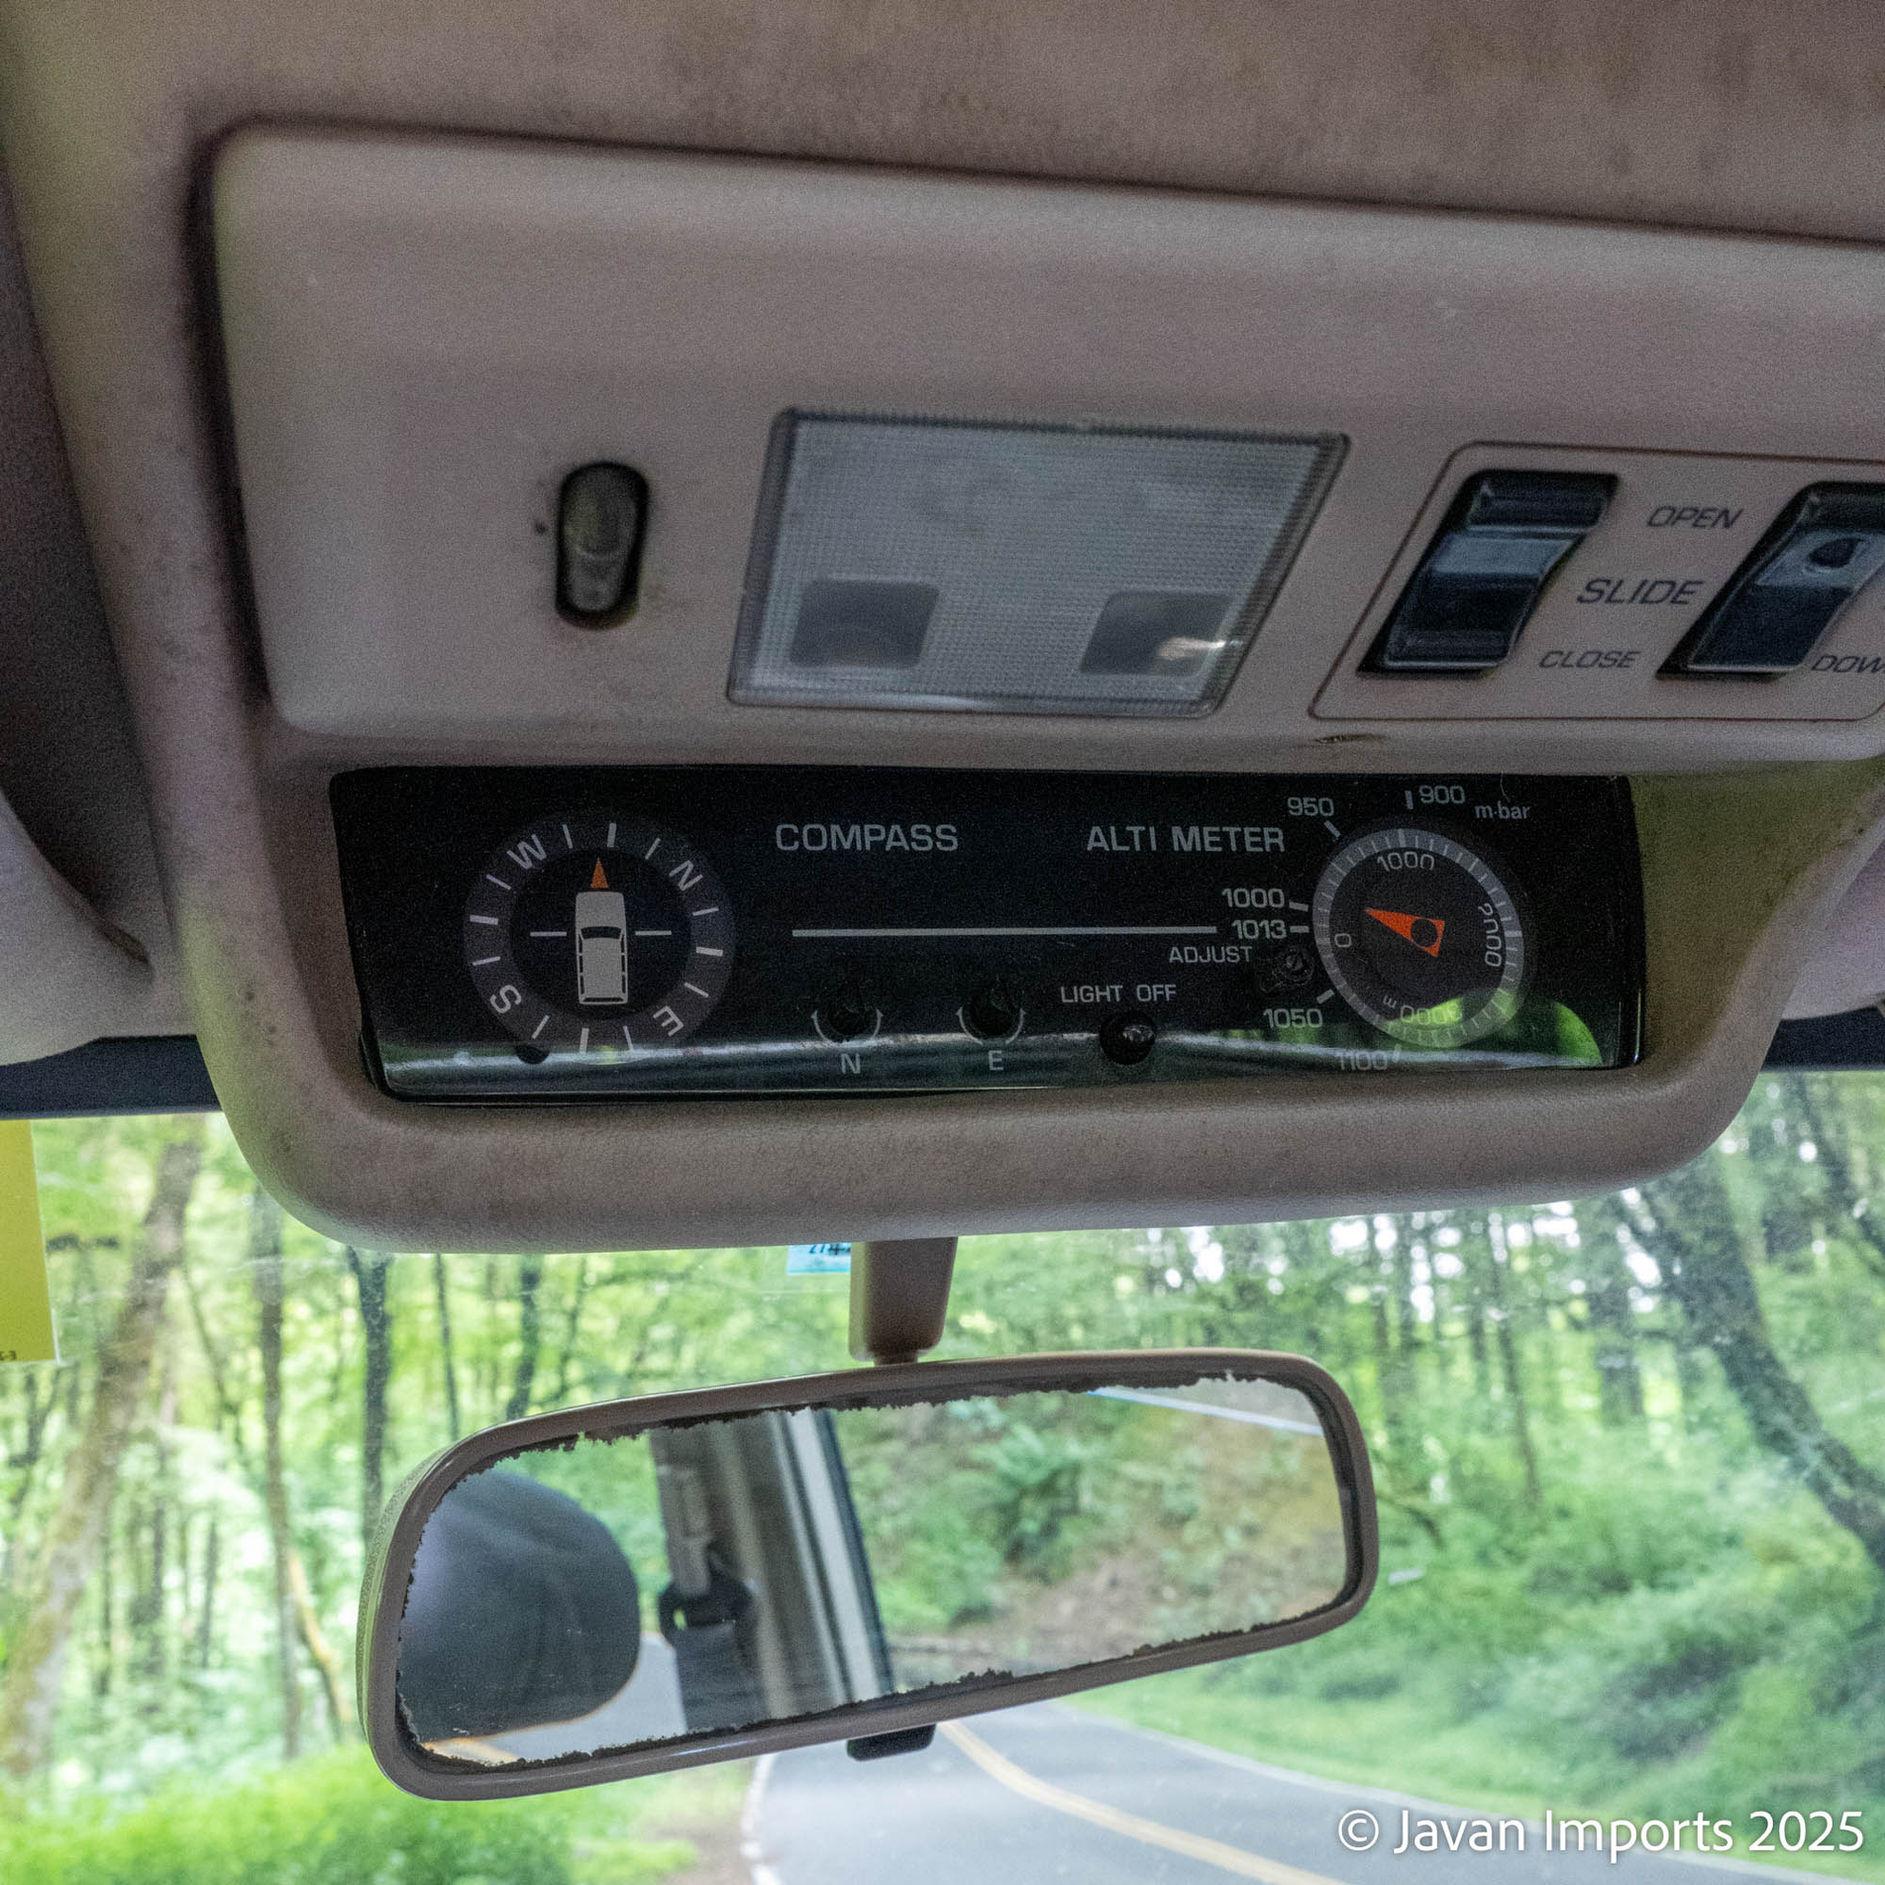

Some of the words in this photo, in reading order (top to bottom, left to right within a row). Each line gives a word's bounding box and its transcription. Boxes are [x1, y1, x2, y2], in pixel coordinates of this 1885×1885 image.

[1647, 505, 1744, 529] OPEN
[1576, 578, 1705, 605] SLIDE
[1539, 650, 1641, 670] CLOSE
[1420, 785, 1465, 804] 900
[1288, 797, 1334, 817] 950
[775, 824, 959, 852] COMPASS
[1087, 826, 1157, 852] ALTI
[1173, 826, 1285, 852] METER
[507, 834, 548, 870] W
[1376, 851, 1435, 871] 1000
[669, 860, 703, 891] N
[1222, 888, 1285, 908] 1000
[1232, 919, 1288, 940] 1013
[1334, 933, 1353, 948] 0
[1478, 903, 1501, 967] 2000
[1169, 946, 1253, 964] ADJUST
[490, 983, 522, 1015] S
[1060, 984, 1124, 1004] LIGHT
[1136, 983, 1177, 1003] OFF
[653, 1005, 685, 1036] E
[1263, 1008, 1322, 1030] 1050
[841, 1053, 862, 1075] N
[988, 1050, 1004, 1072] E
[1337, 1049, 1388, 1071] 1100
